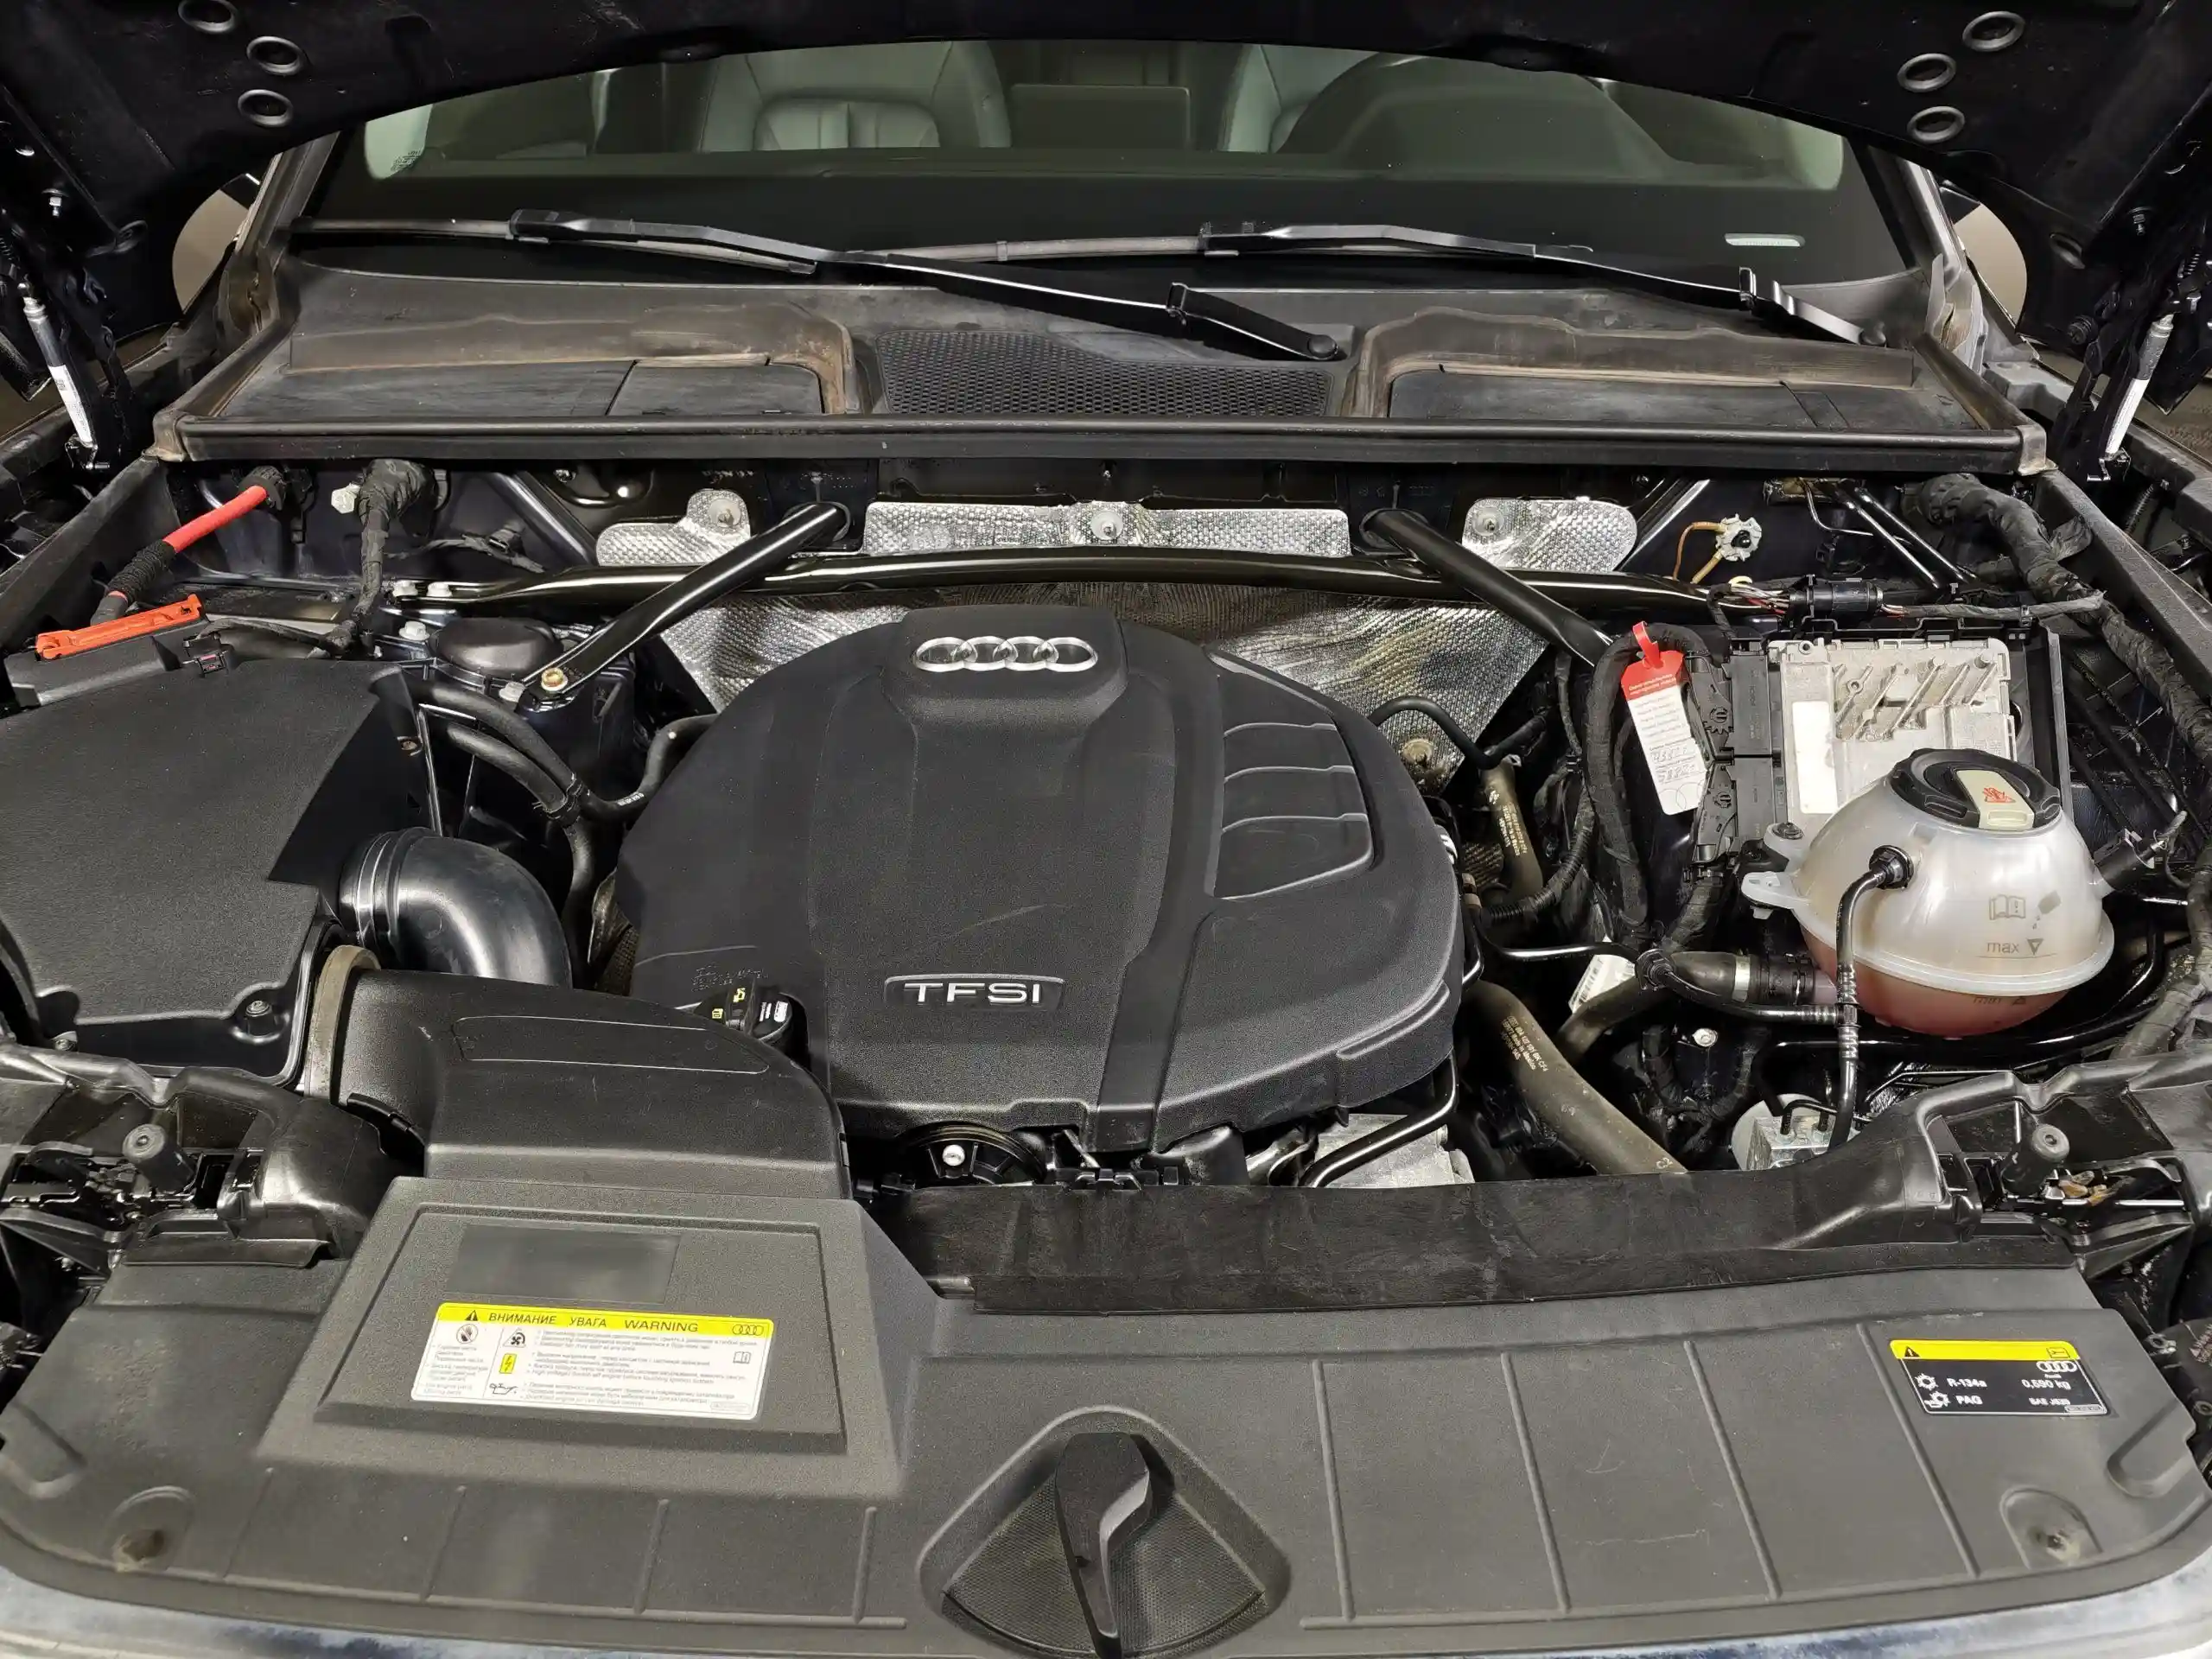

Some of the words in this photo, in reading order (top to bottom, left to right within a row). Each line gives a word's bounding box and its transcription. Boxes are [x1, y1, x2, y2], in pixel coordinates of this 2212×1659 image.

[1986, 942, 2020, 954] max
[904, 982, 1040, 1004] TFSI
[488, 1313, 556, 1325] ВНИМАНИЕ
[569, 1318, 607, 1328] УВАГА
[625, 1319, 698, 1332] WARNING
[1946, 1377, 1987, 1388] R-134a
[2056, 1379, 2071, 1390] kg
[1955, 1395, 1983, 1405] PAG
